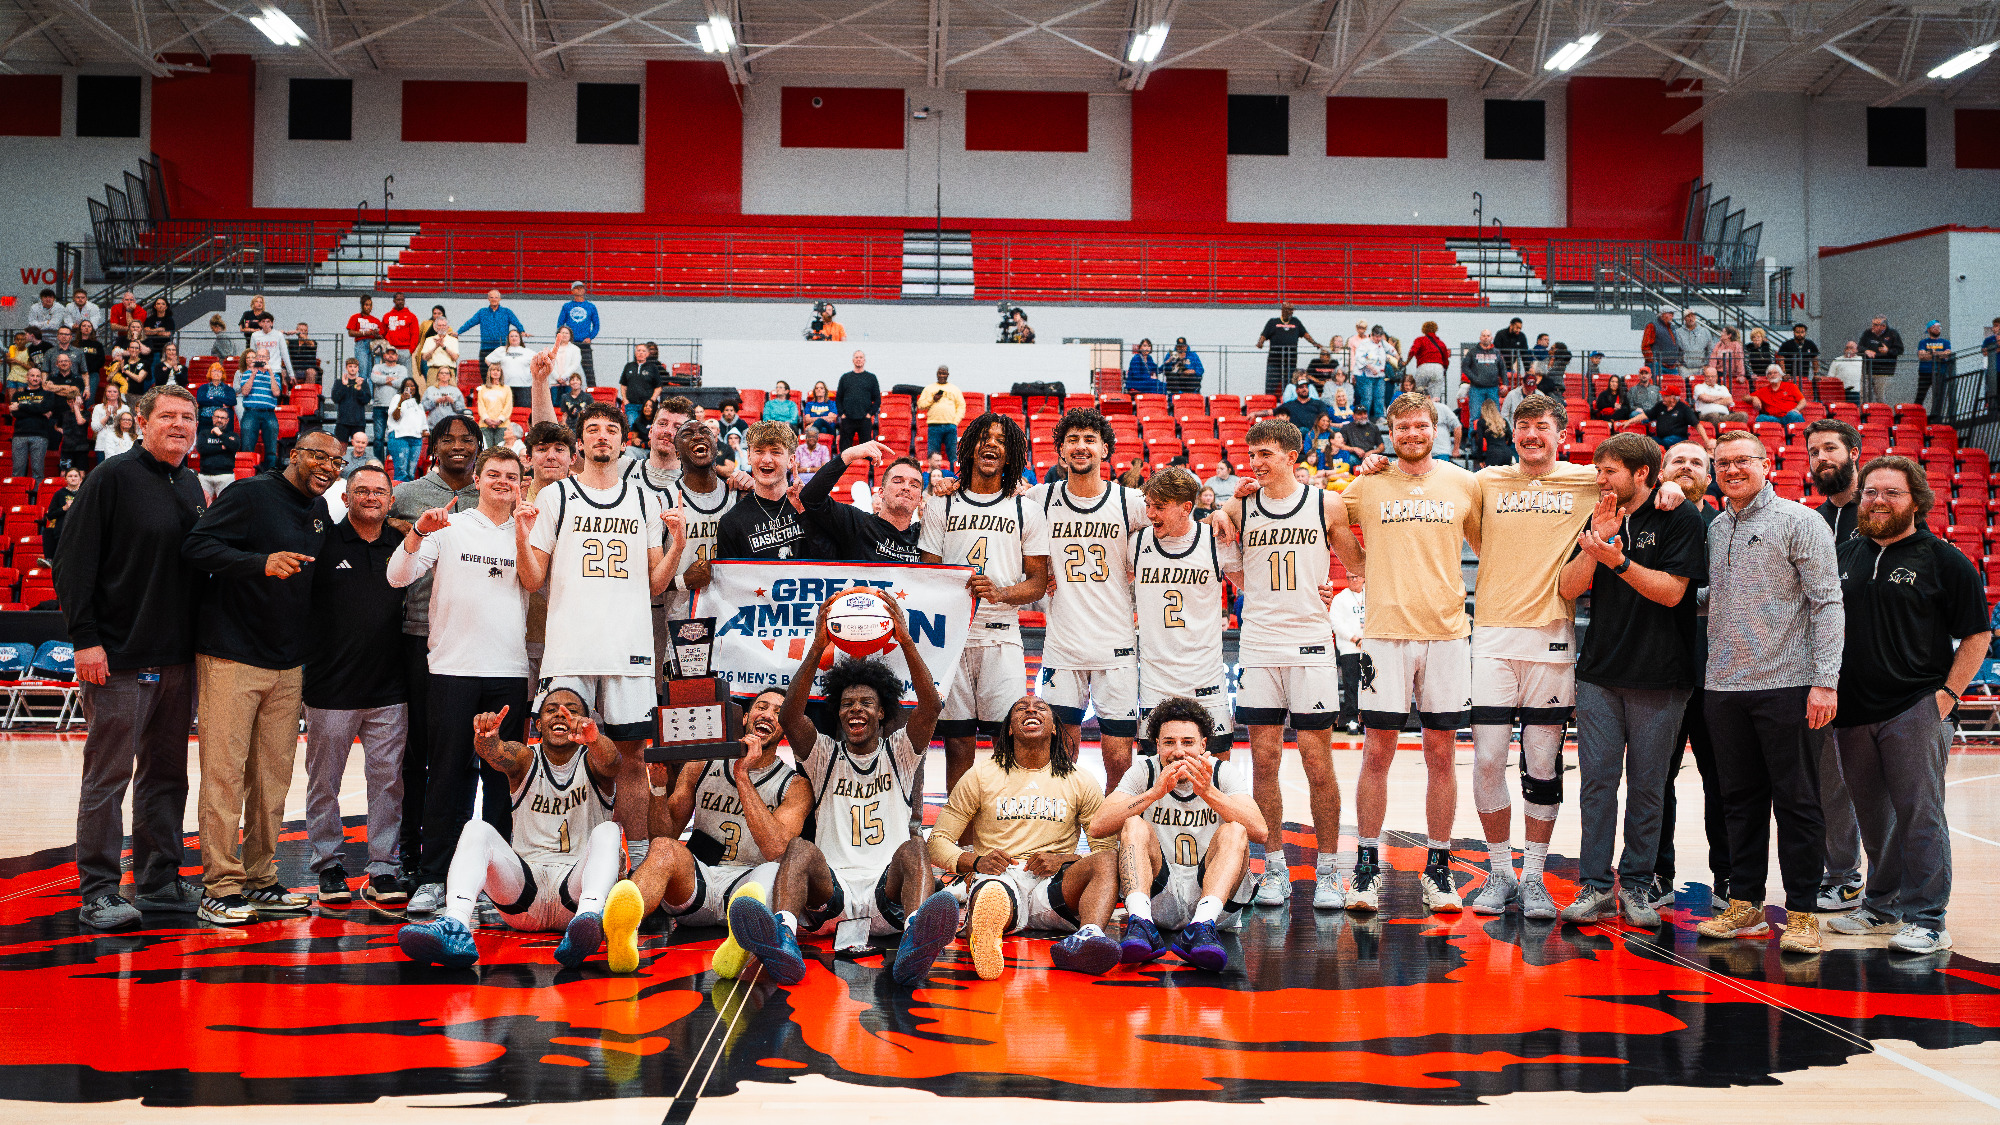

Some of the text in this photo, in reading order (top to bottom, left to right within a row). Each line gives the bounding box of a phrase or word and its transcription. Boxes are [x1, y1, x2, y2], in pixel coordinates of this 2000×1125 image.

[573, 516, 639, 535] HARDING
[946, 515, 1016, 535] HARDING
[1051, 522, 1120, 539] HARDING
[1248, 528, 1318, 547] HARDING
[461, 552, 516, 568] NEVER LOSE YOUR
[582, 538, 629, 579] 22
[966, 536, 989, 575] 4
[1063, 543, 1110, 583] 23
[1140, 567, 1211, 585] HARDING
[1267, 551, 1297, 592] 11
[1163, 589, 1186, 629] 2
[737, 671, 777, 685] MEN'S
[850, 800, 884, 847] 15
[1152, 806, 1218, 827] HARDING
[557, 818, 571, 853] 1
[718, 820, 742, 862] 3
